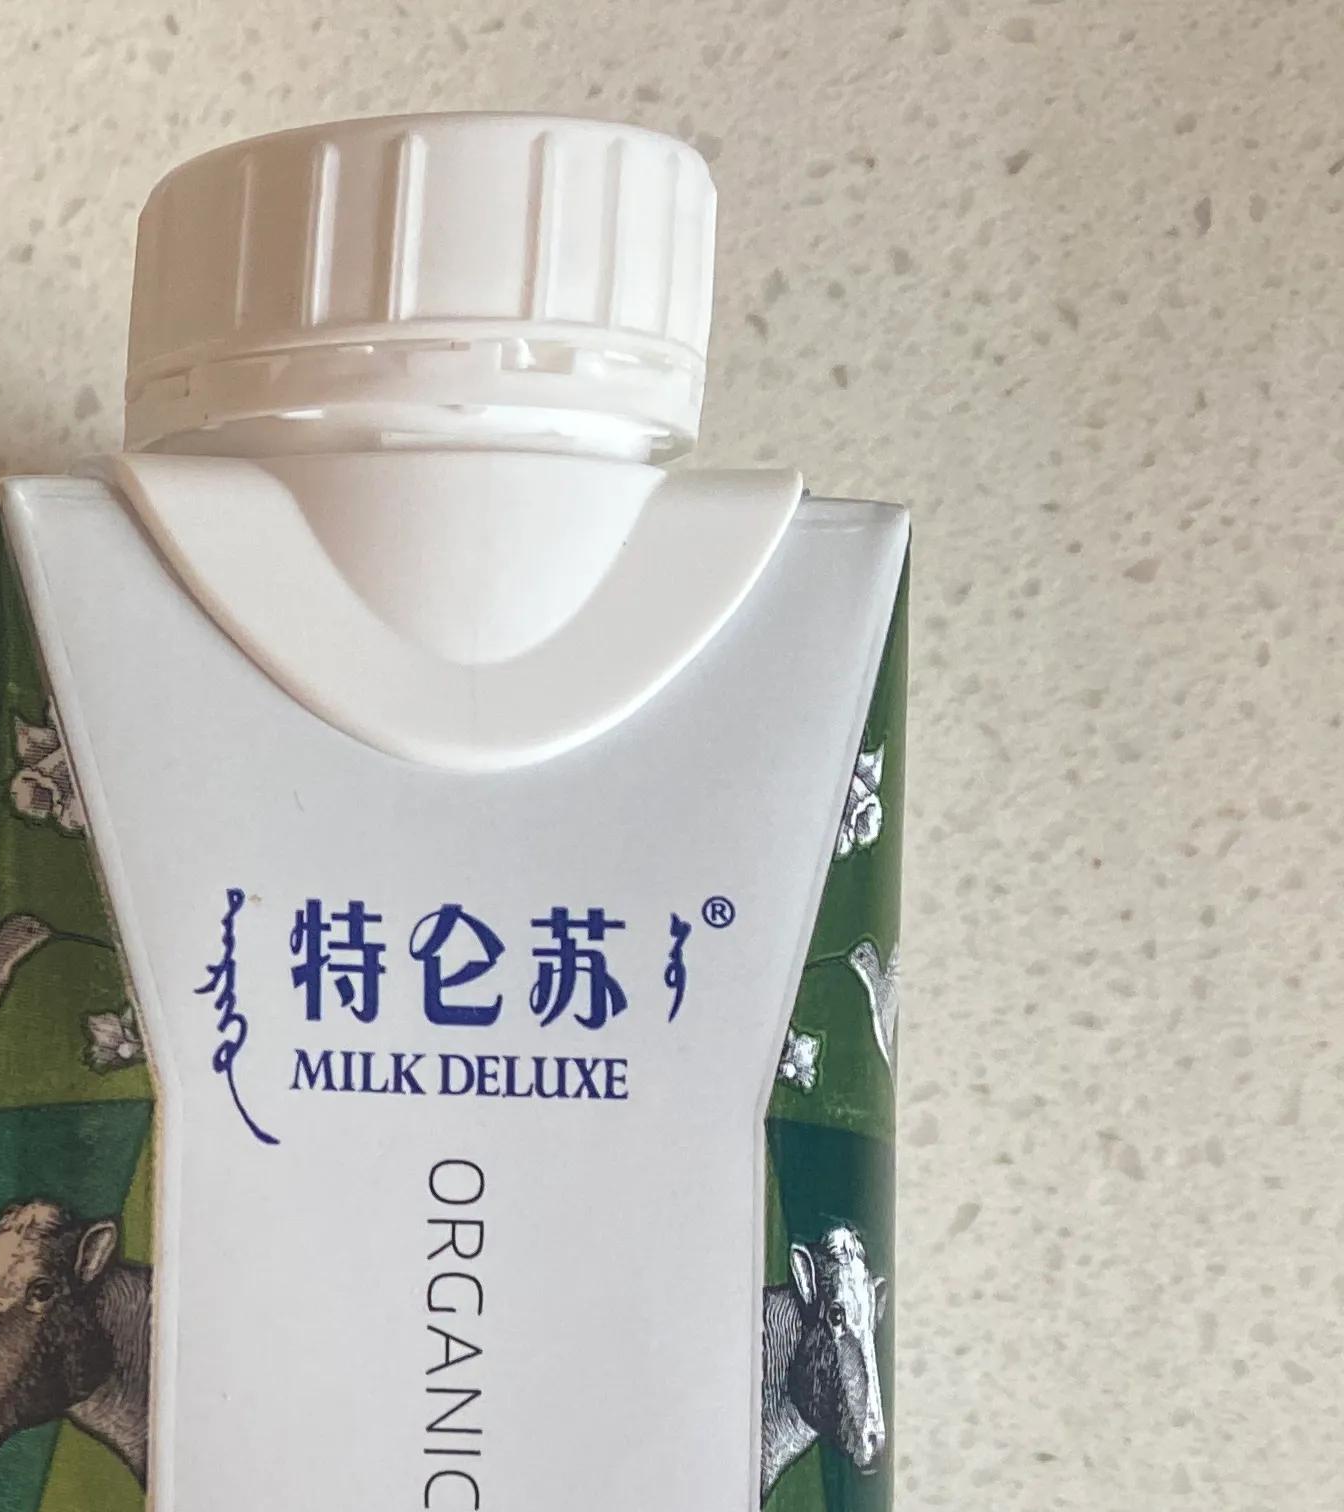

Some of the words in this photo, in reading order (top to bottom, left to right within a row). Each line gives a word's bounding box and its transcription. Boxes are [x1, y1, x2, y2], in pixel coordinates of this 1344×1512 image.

[289, 898, 628, 1030] 特仑苏
[289, 1049, 426, 1095] MILK
[437, 1053, 629, 1101] DELUXE
[423, 1158, 486, 1511] ORGANIC
